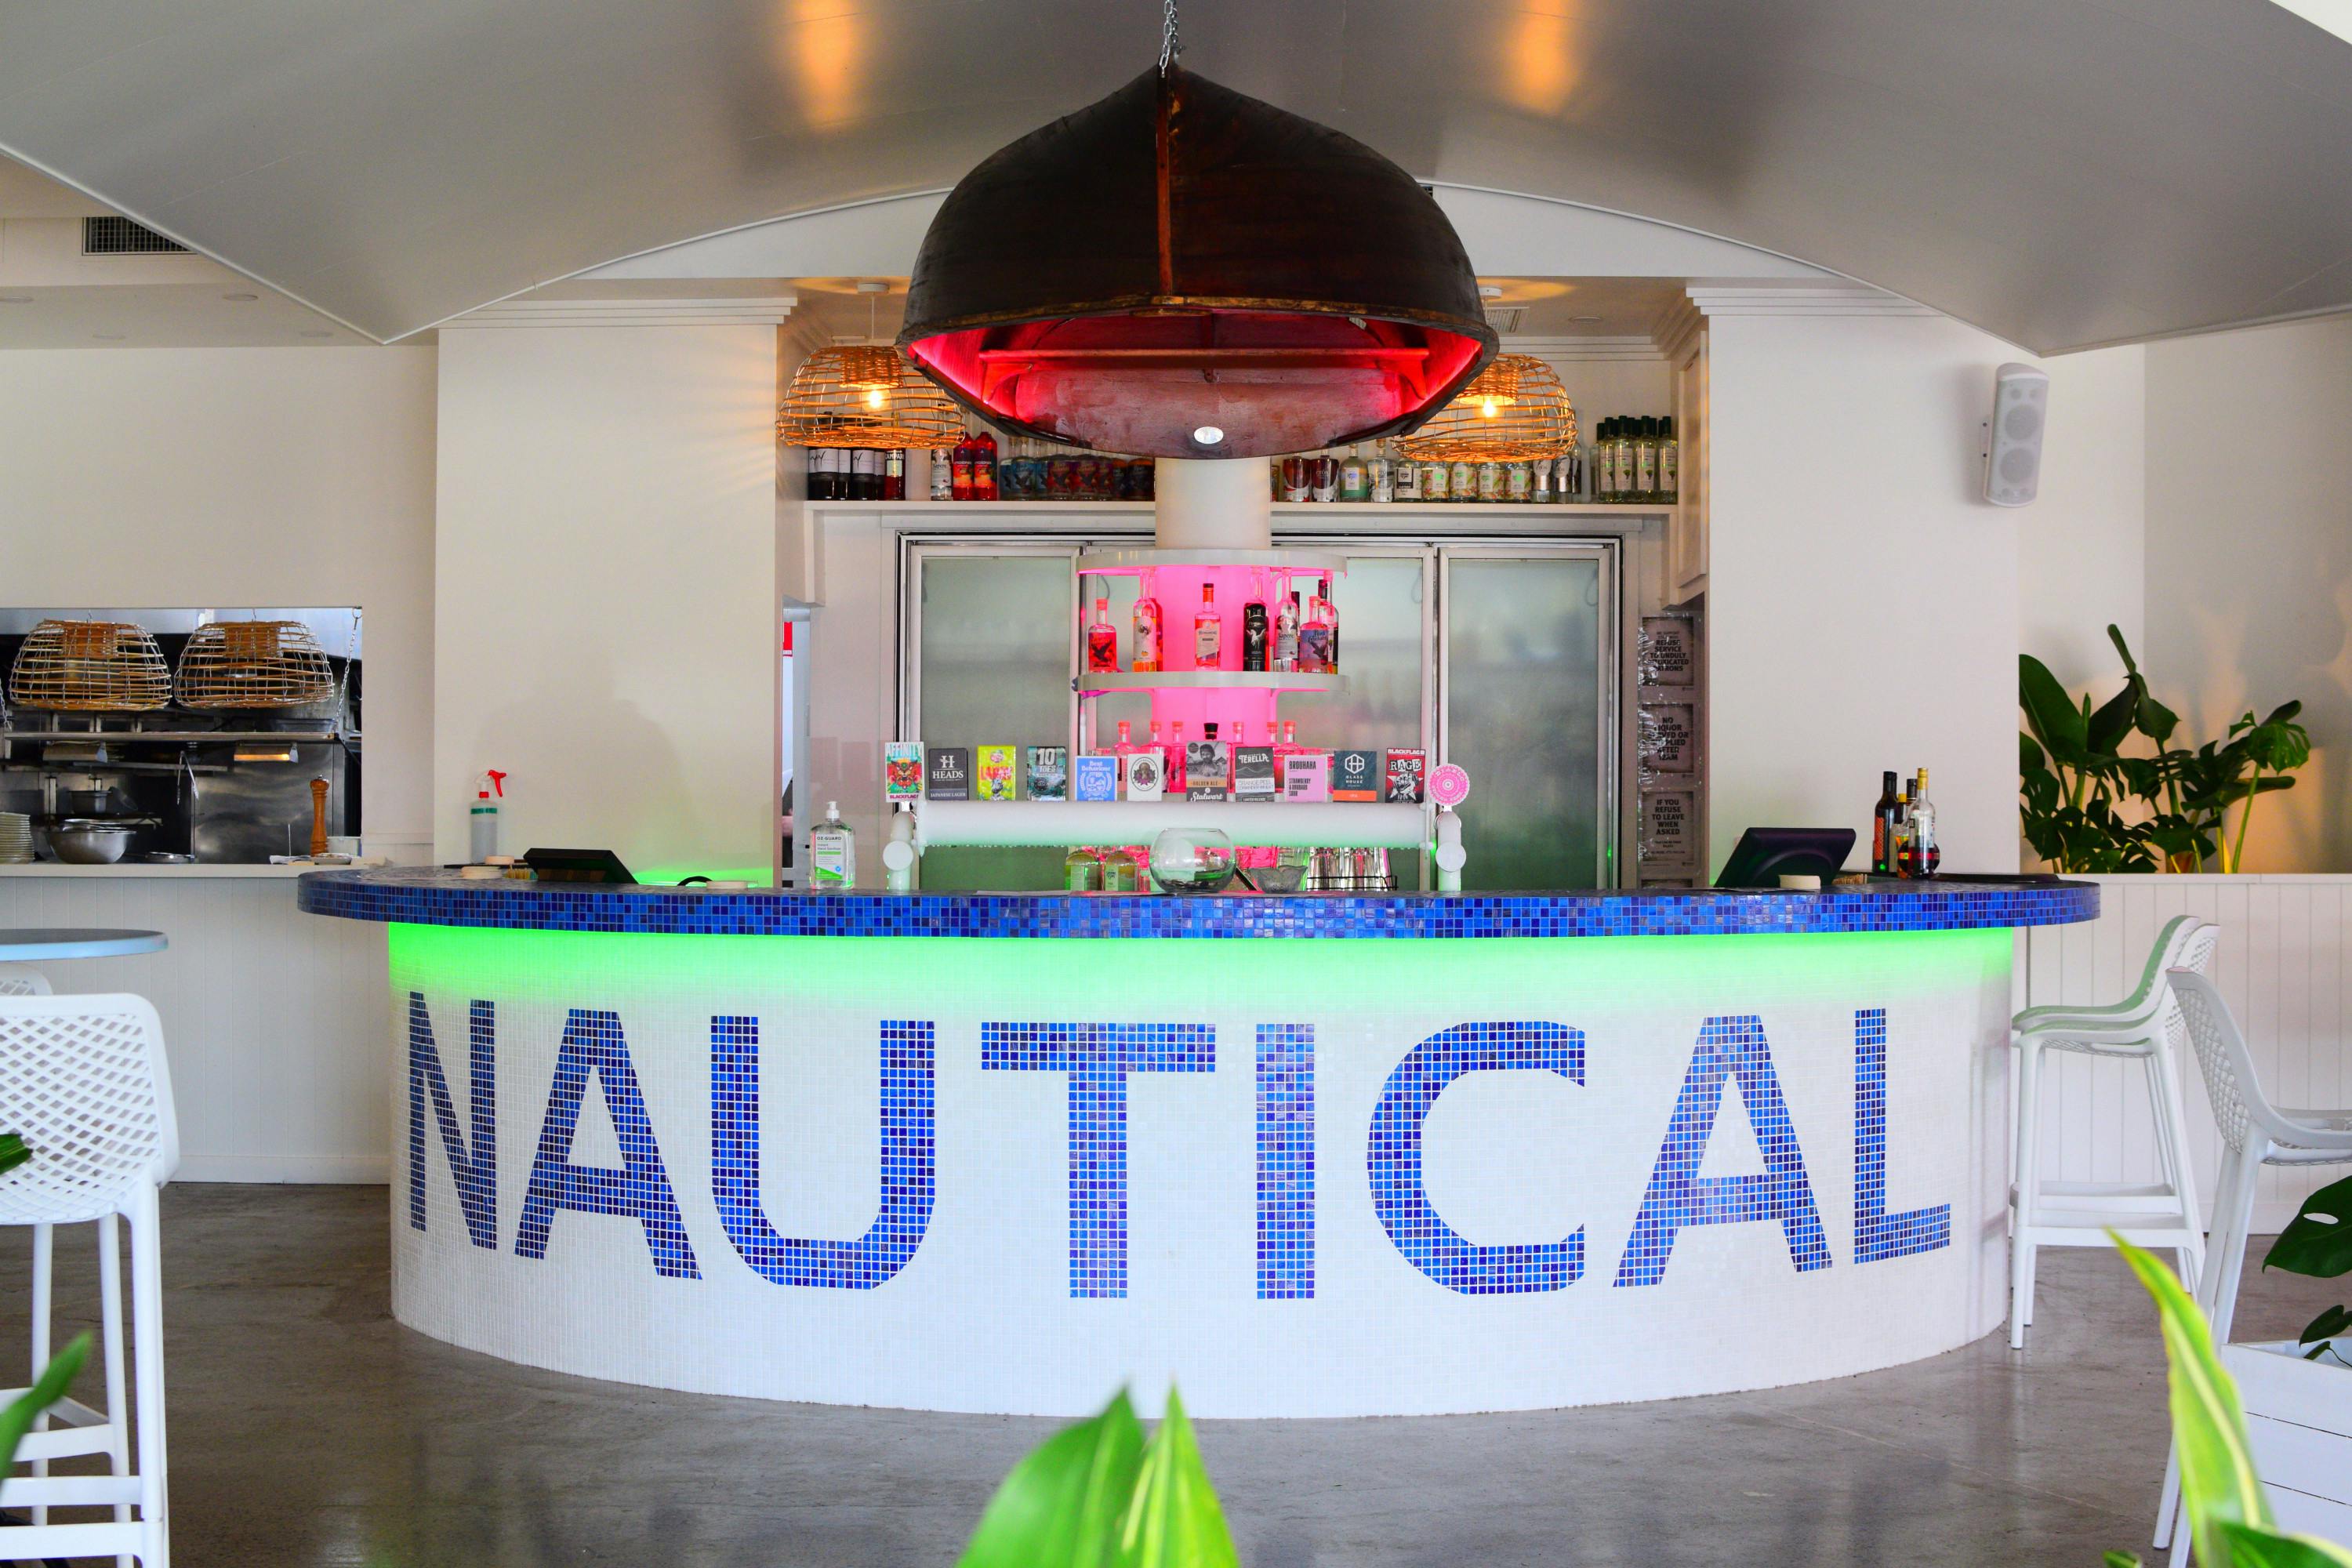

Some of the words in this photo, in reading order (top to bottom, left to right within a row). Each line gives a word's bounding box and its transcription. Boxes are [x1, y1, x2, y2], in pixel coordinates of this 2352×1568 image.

[1037, 748, 1055, 765] 10
[1289, 760, 1316, 770] BROUHAHA
[1389, 759, 1421, 771] RAGE
[932, 771, 964, 779] HEADS
[1190, 792, 1224, 802] Stalwart
[409, 991, 1950, 1298] NAUTICAL
